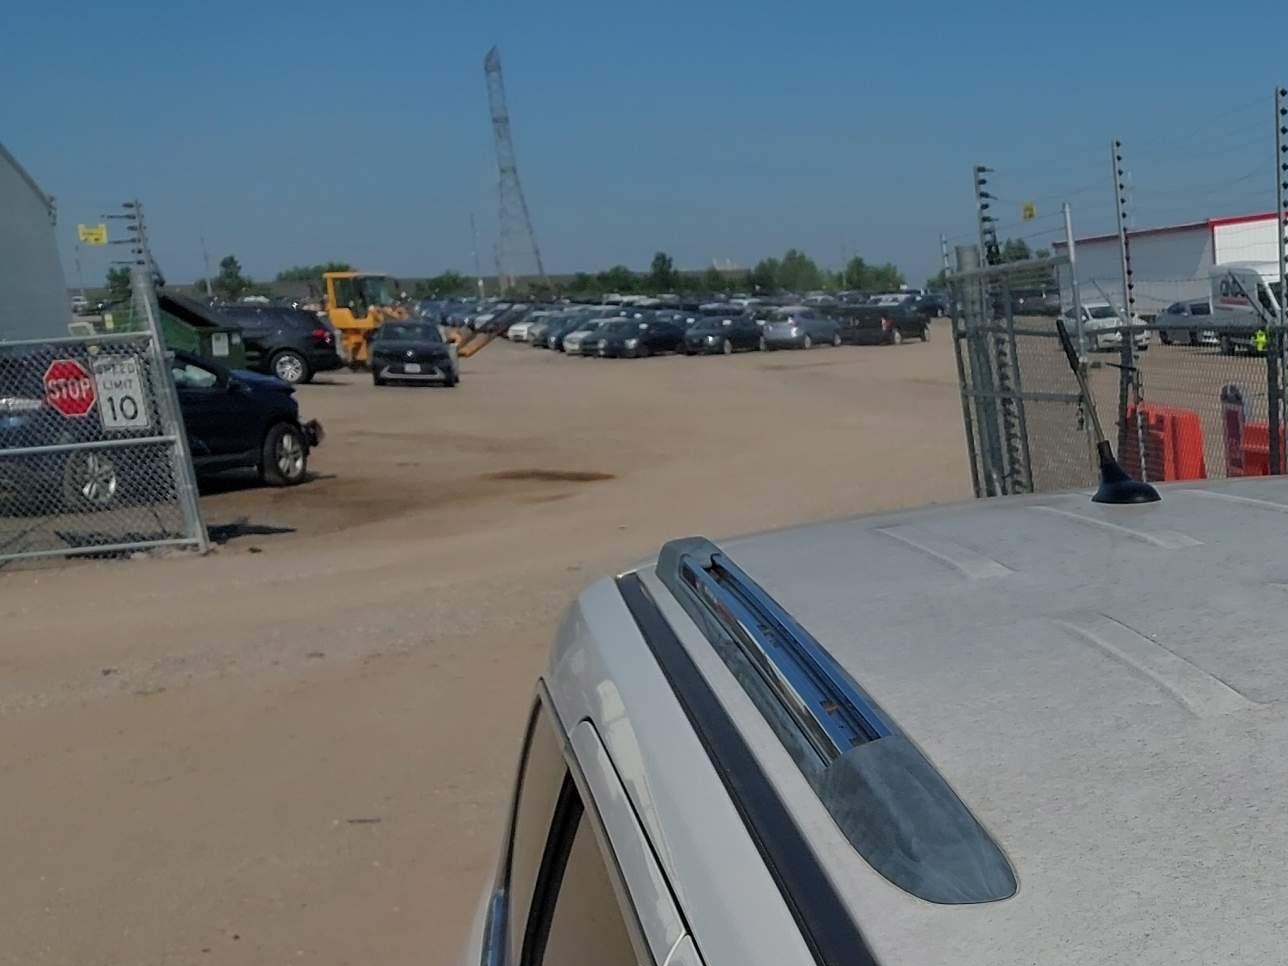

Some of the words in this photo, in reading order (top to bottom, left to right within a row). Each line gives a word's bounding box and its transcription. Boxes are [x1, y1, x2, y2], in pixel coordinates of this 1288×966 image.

[48, 378, 90, 400] STOP
[103, 379, 132, 390] LIMIT
[107, 395, 138, 421] 10
